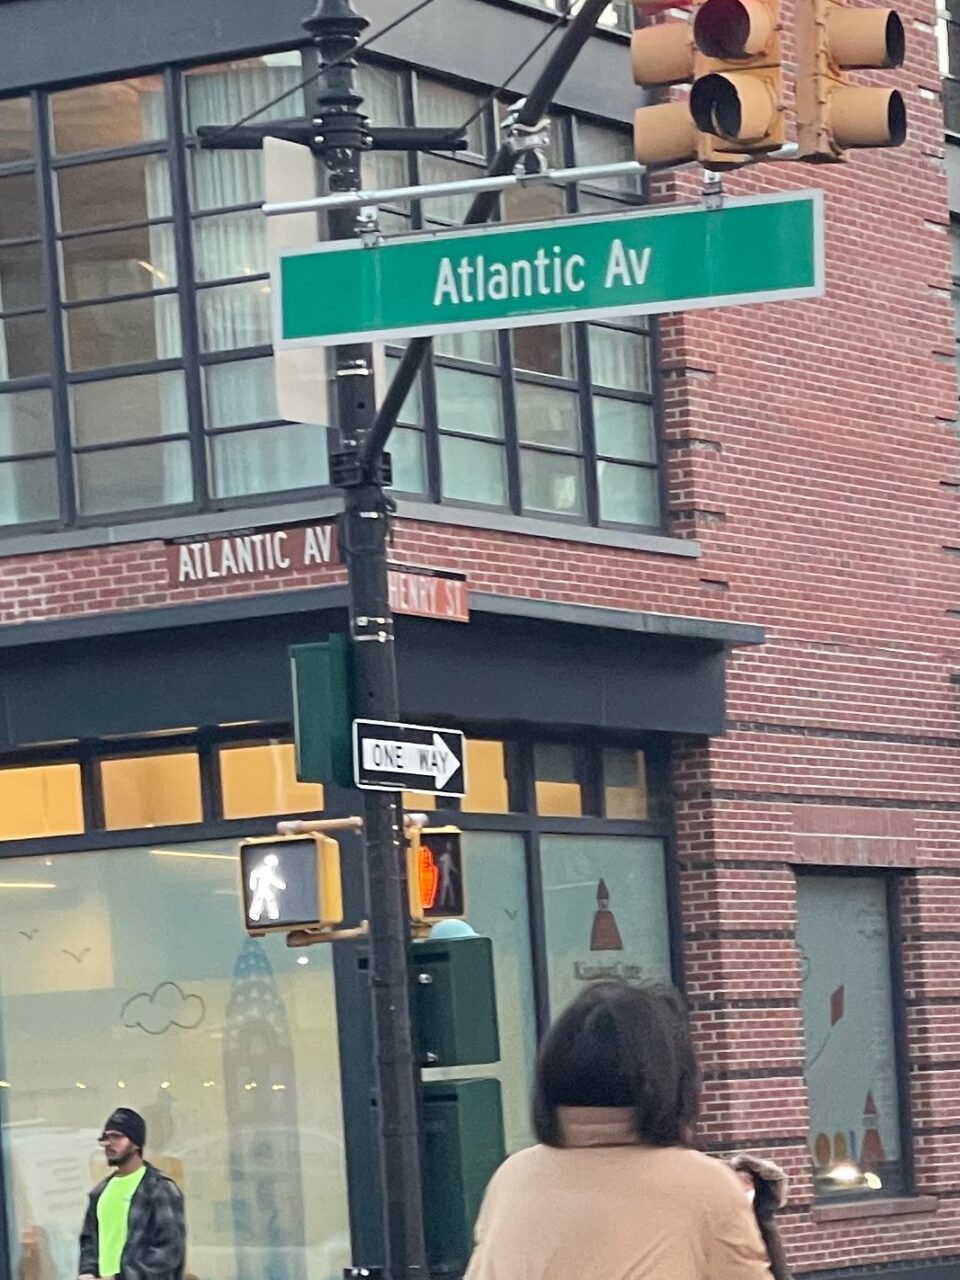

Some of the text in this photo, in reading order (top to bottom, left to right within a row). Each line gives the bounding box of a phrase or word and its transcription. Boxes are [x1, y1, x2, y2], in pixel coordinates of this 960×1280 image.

[433, 238, 651, 306] Atlantic Av
[178, 525, 332, 582] ATLANTIC AV
[388, 571, 465, 617] HENRY ST
[373, 743, 449, 775] ONE WAY
